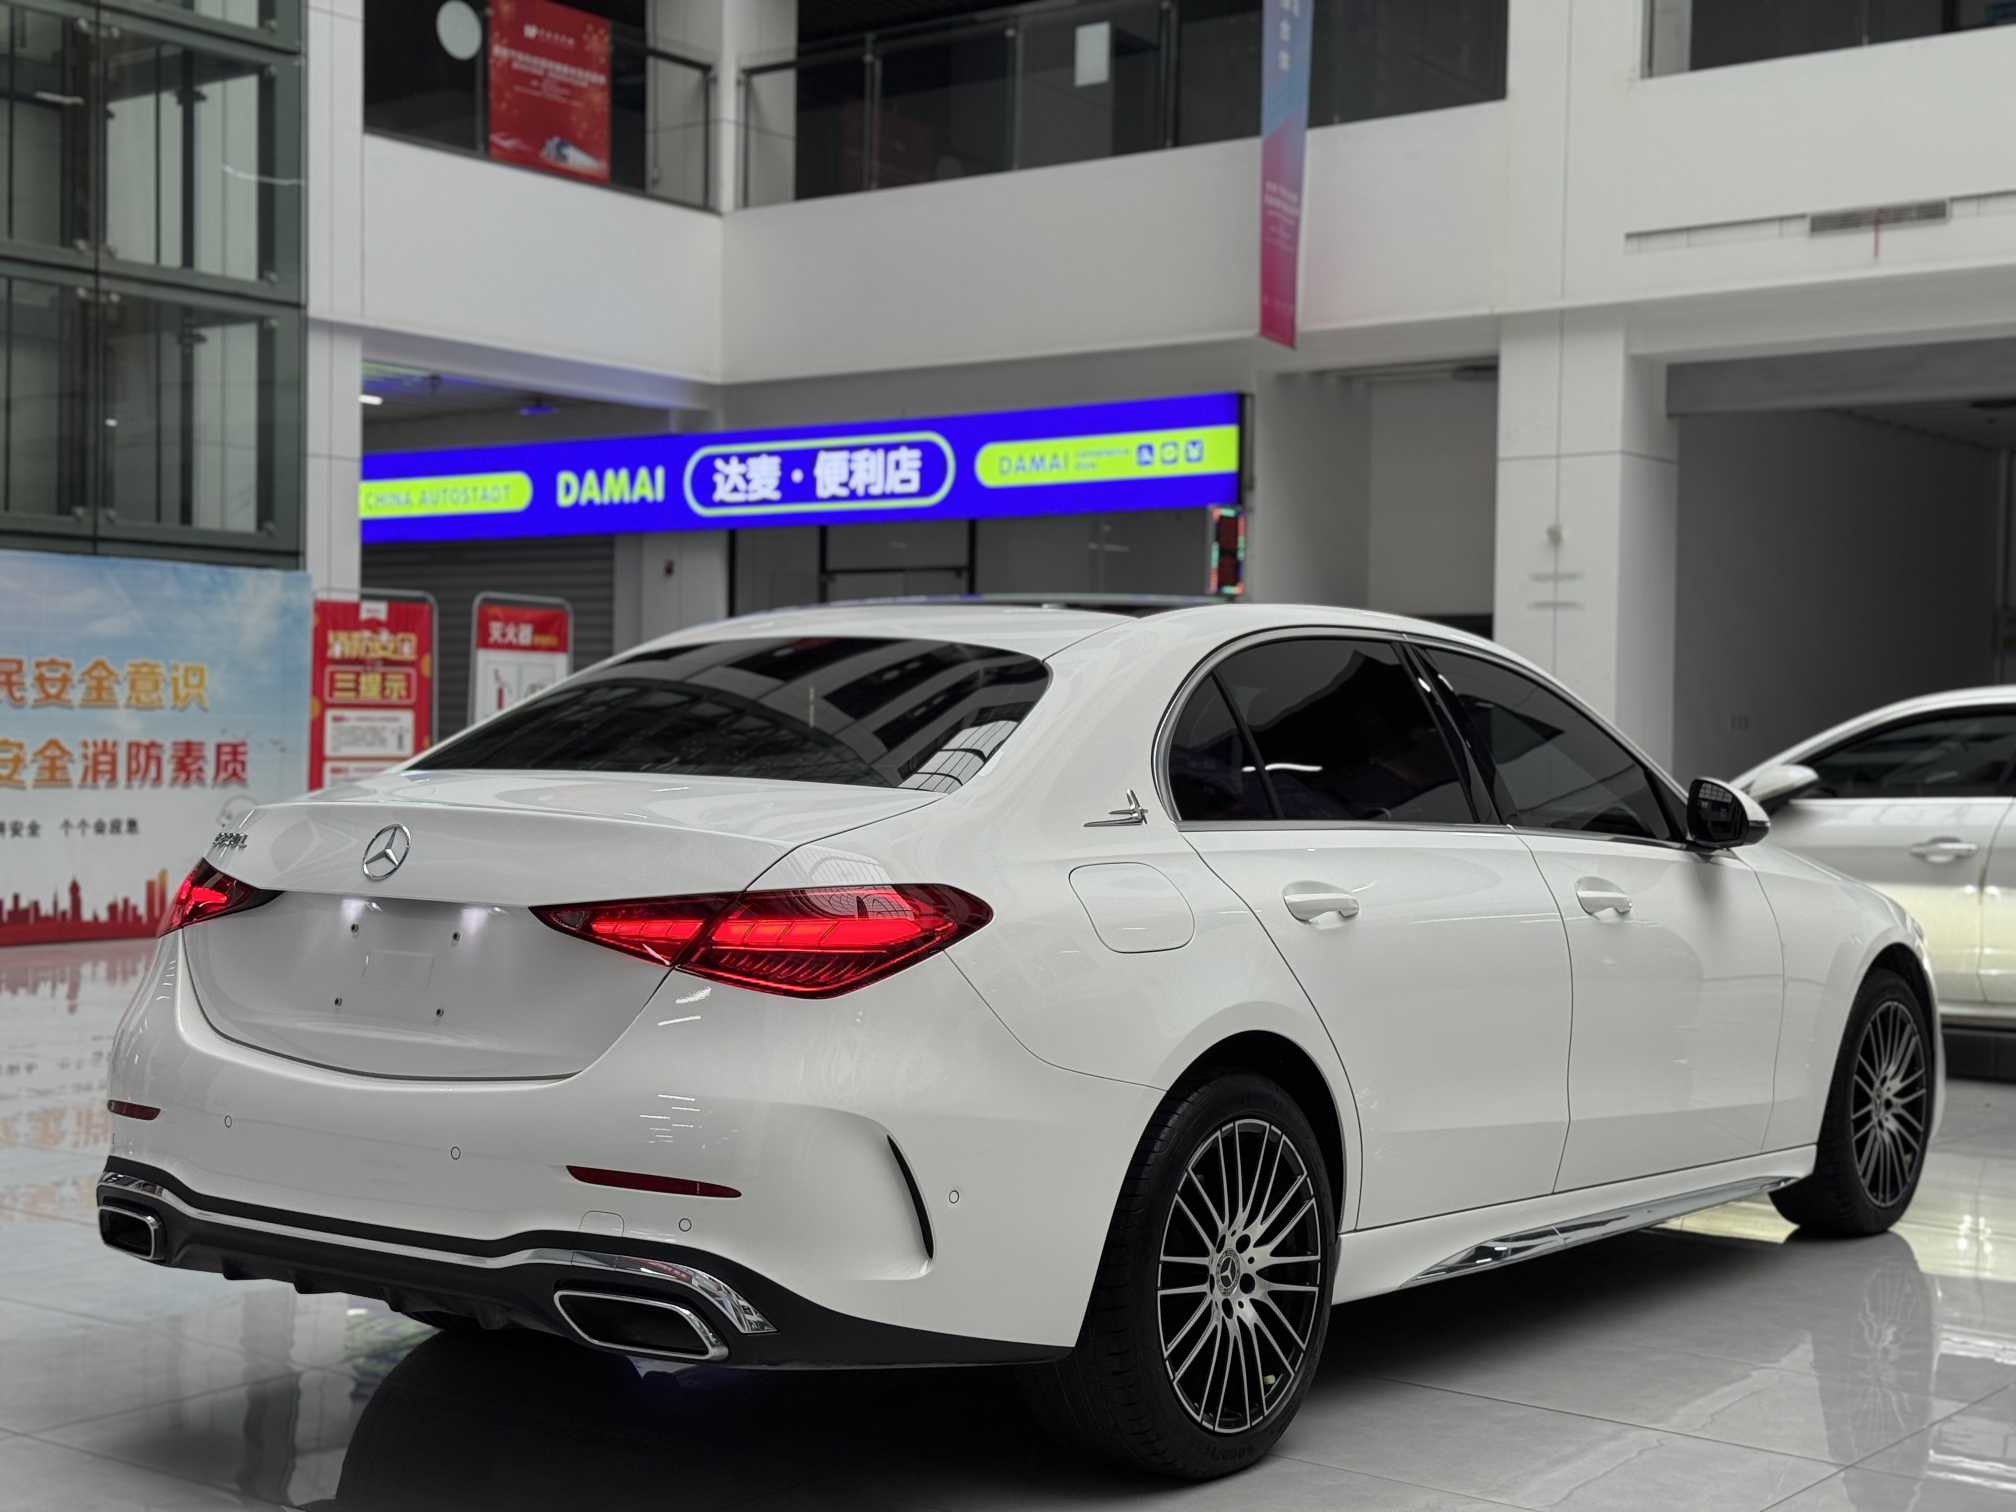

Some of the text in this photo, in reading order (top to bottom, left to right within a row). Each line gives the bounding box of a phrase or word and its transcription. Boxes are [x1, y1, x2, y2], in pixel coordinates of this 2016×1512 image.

[998, 453, 1068, 476] DAMAI
[556, 465, 665, 508] DAMAI
[363, 489, 412, 511] CHINA
